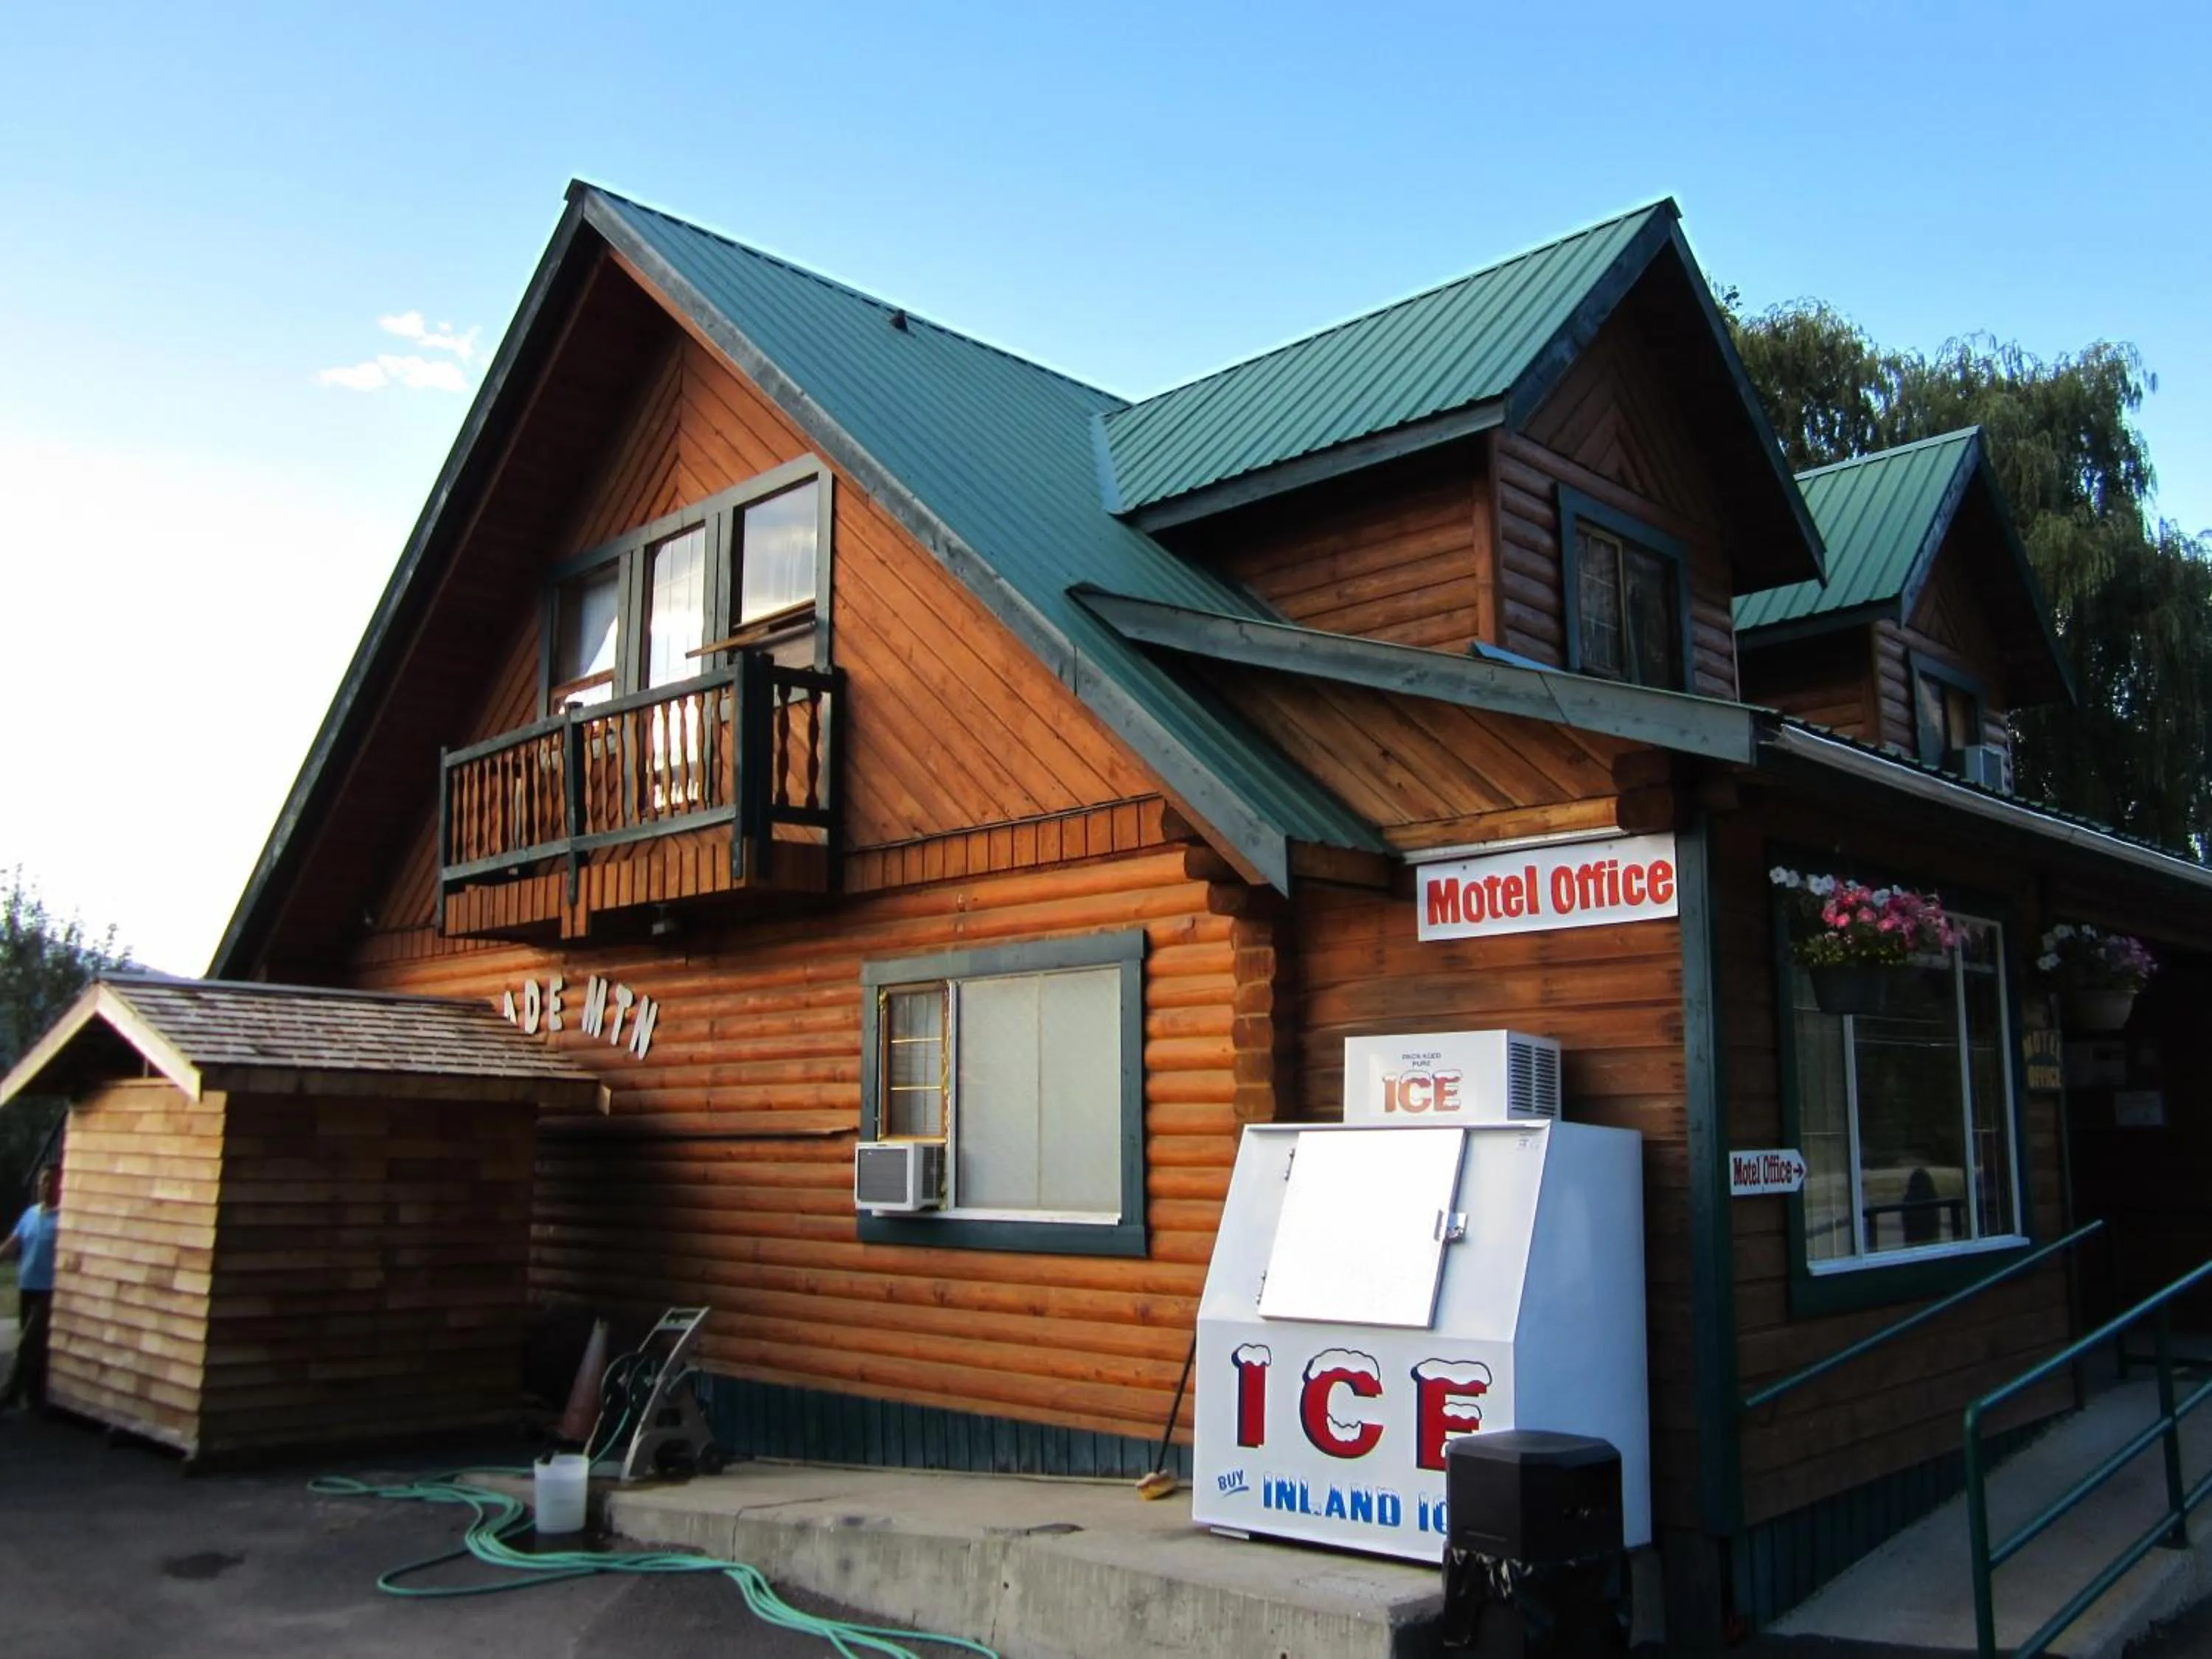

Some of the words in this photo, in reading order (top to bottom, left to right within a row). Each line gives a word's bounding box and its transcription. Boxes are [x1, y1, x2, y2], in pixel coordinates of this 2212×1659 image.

[1427, 865, 1540, 925] Motel
[1551, 859, 1674, 914] Office
[581, 975, 658, 1060] MTN
[1382, 1069, 1463, 1113] ICE
[1733, 1155, 1760, 1186] Motel
[1763, 1154, 1792, 1184] Office
[1231, 1343, 1492, 1472] ICE
[1217, 1469, 1244, 1490] BUY
[1262, 1472, 1402, 1527] INLAND
[1417, 1491, 1448, 1535] IC
